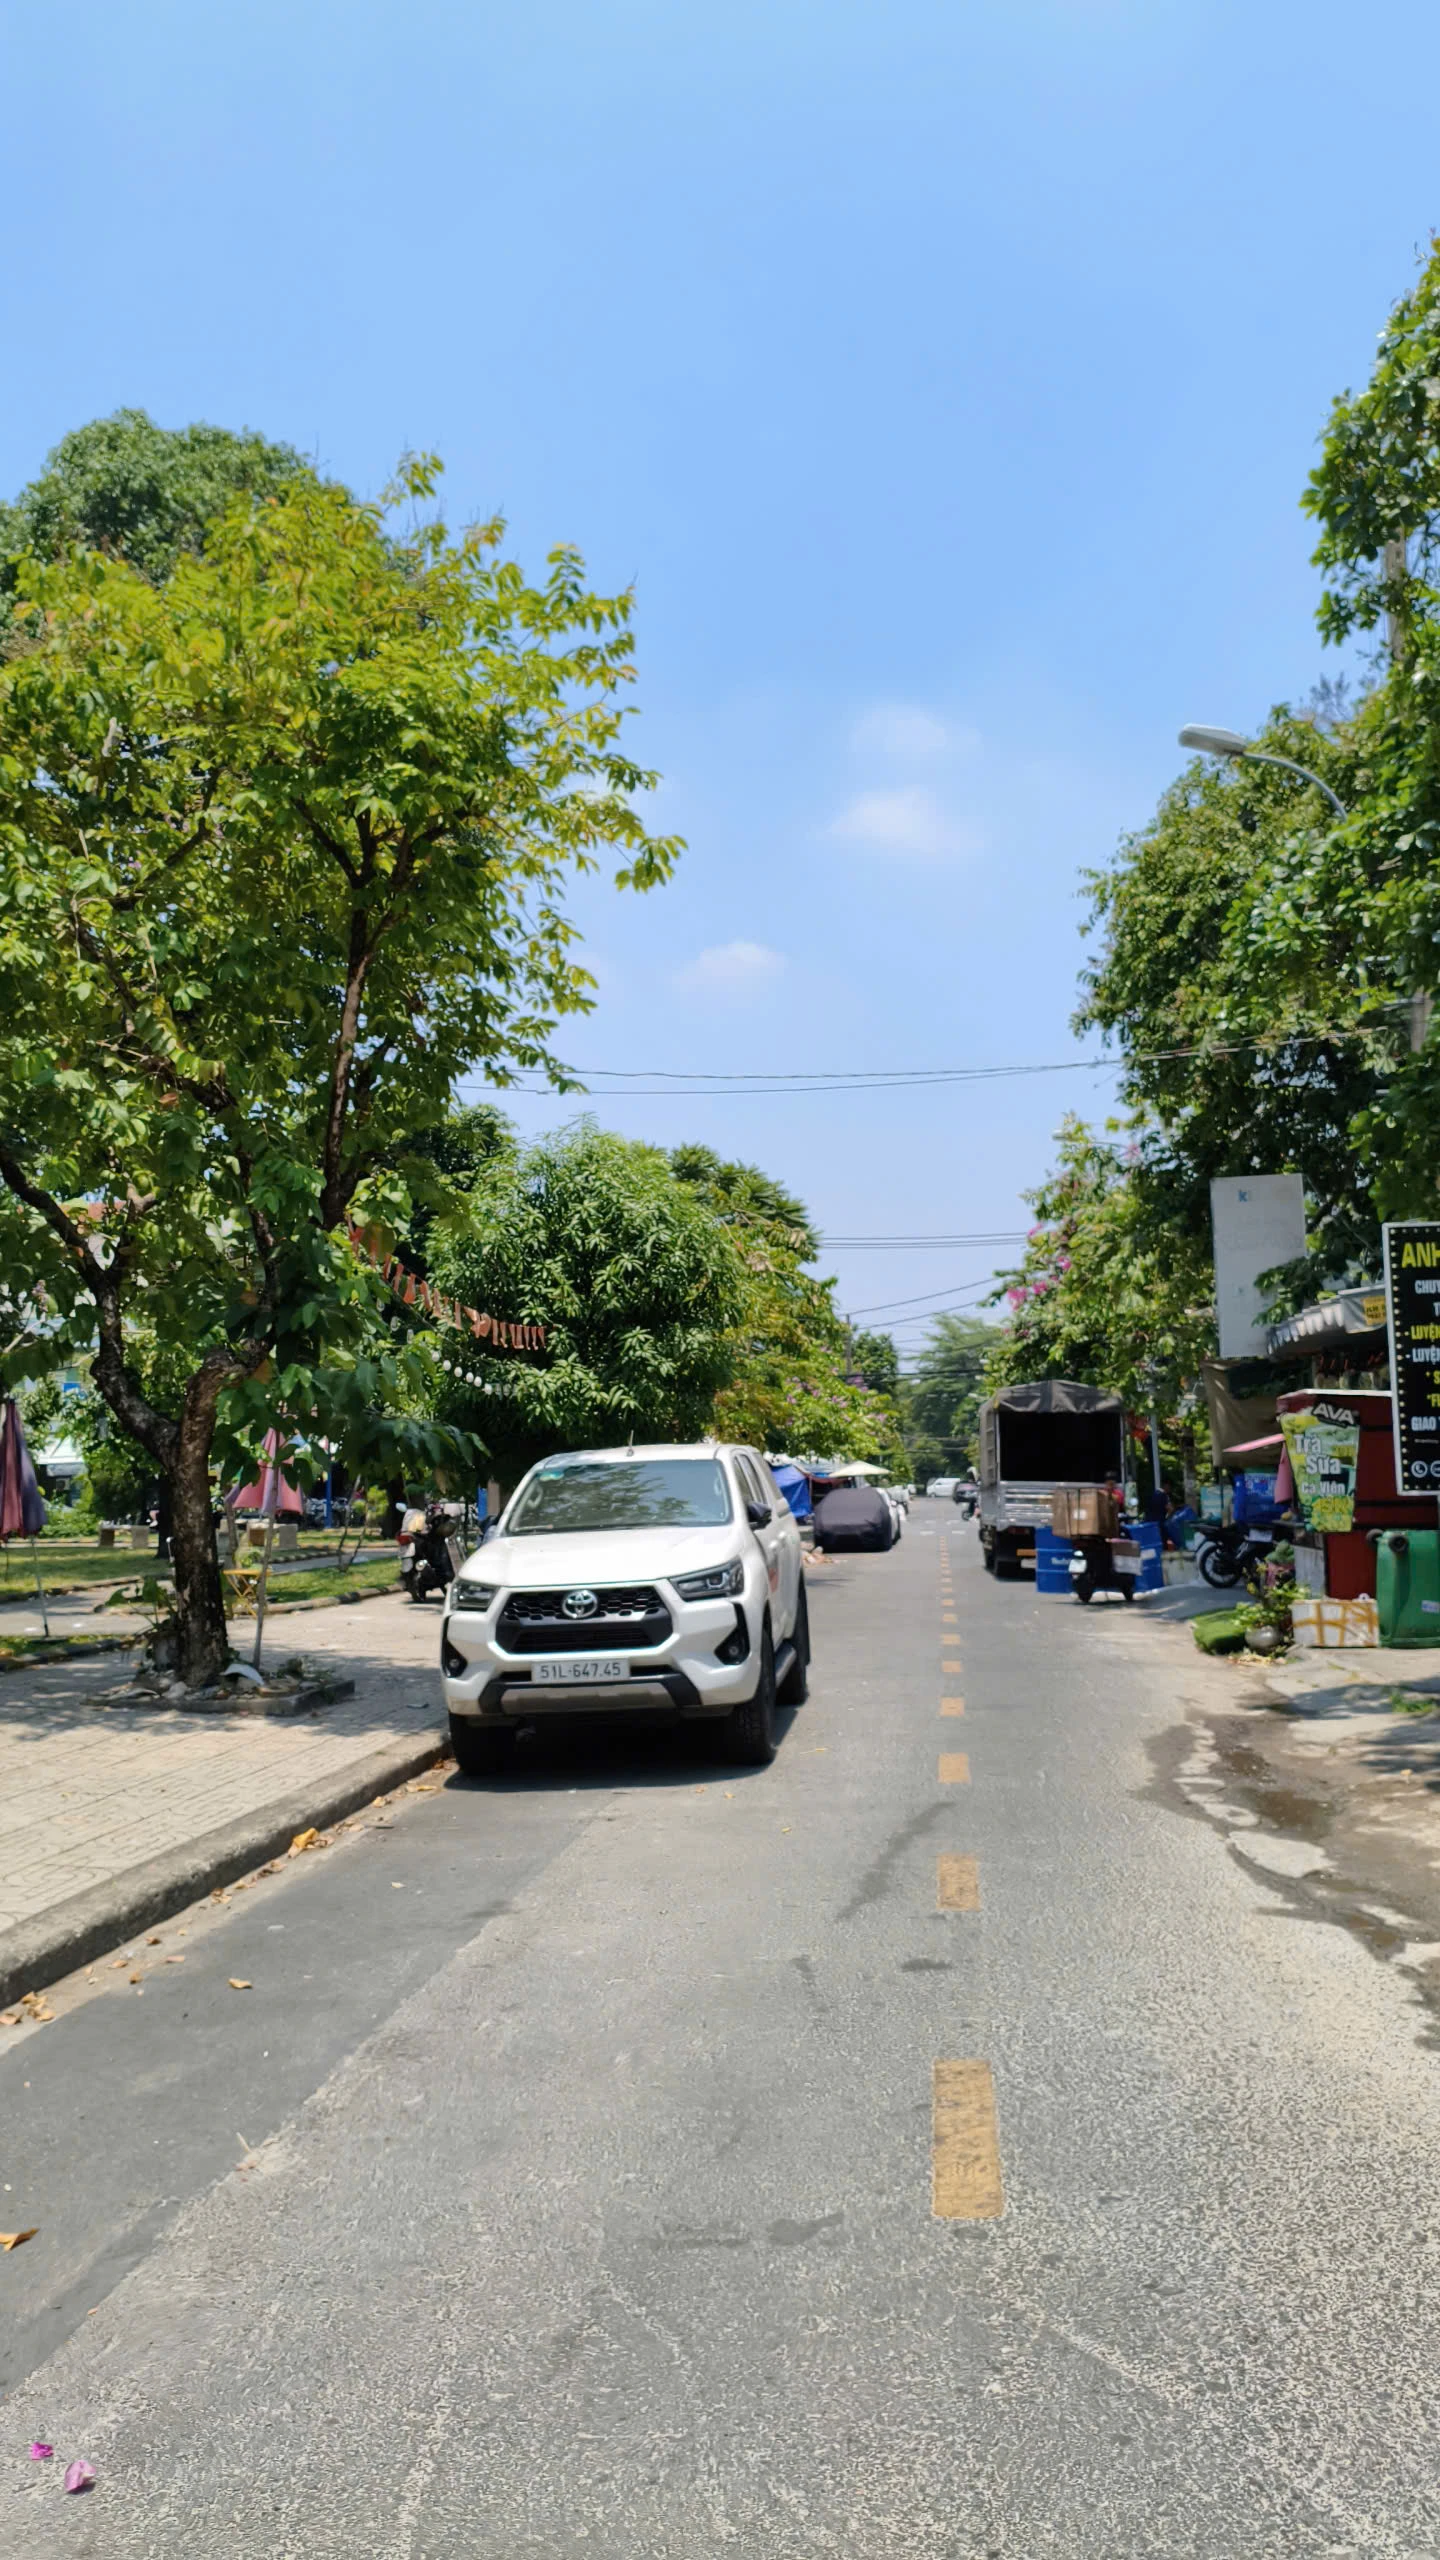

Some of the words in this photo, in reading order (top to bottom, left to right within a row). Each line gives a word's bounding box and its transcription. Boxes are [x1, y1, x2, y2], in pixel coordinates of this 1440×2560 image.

[1312, 1402, 1355, 1425] AVA
[1410, 1416, 1437, 1431] GIAO
[540, 1662, 621, 1679] 51L-647.45
